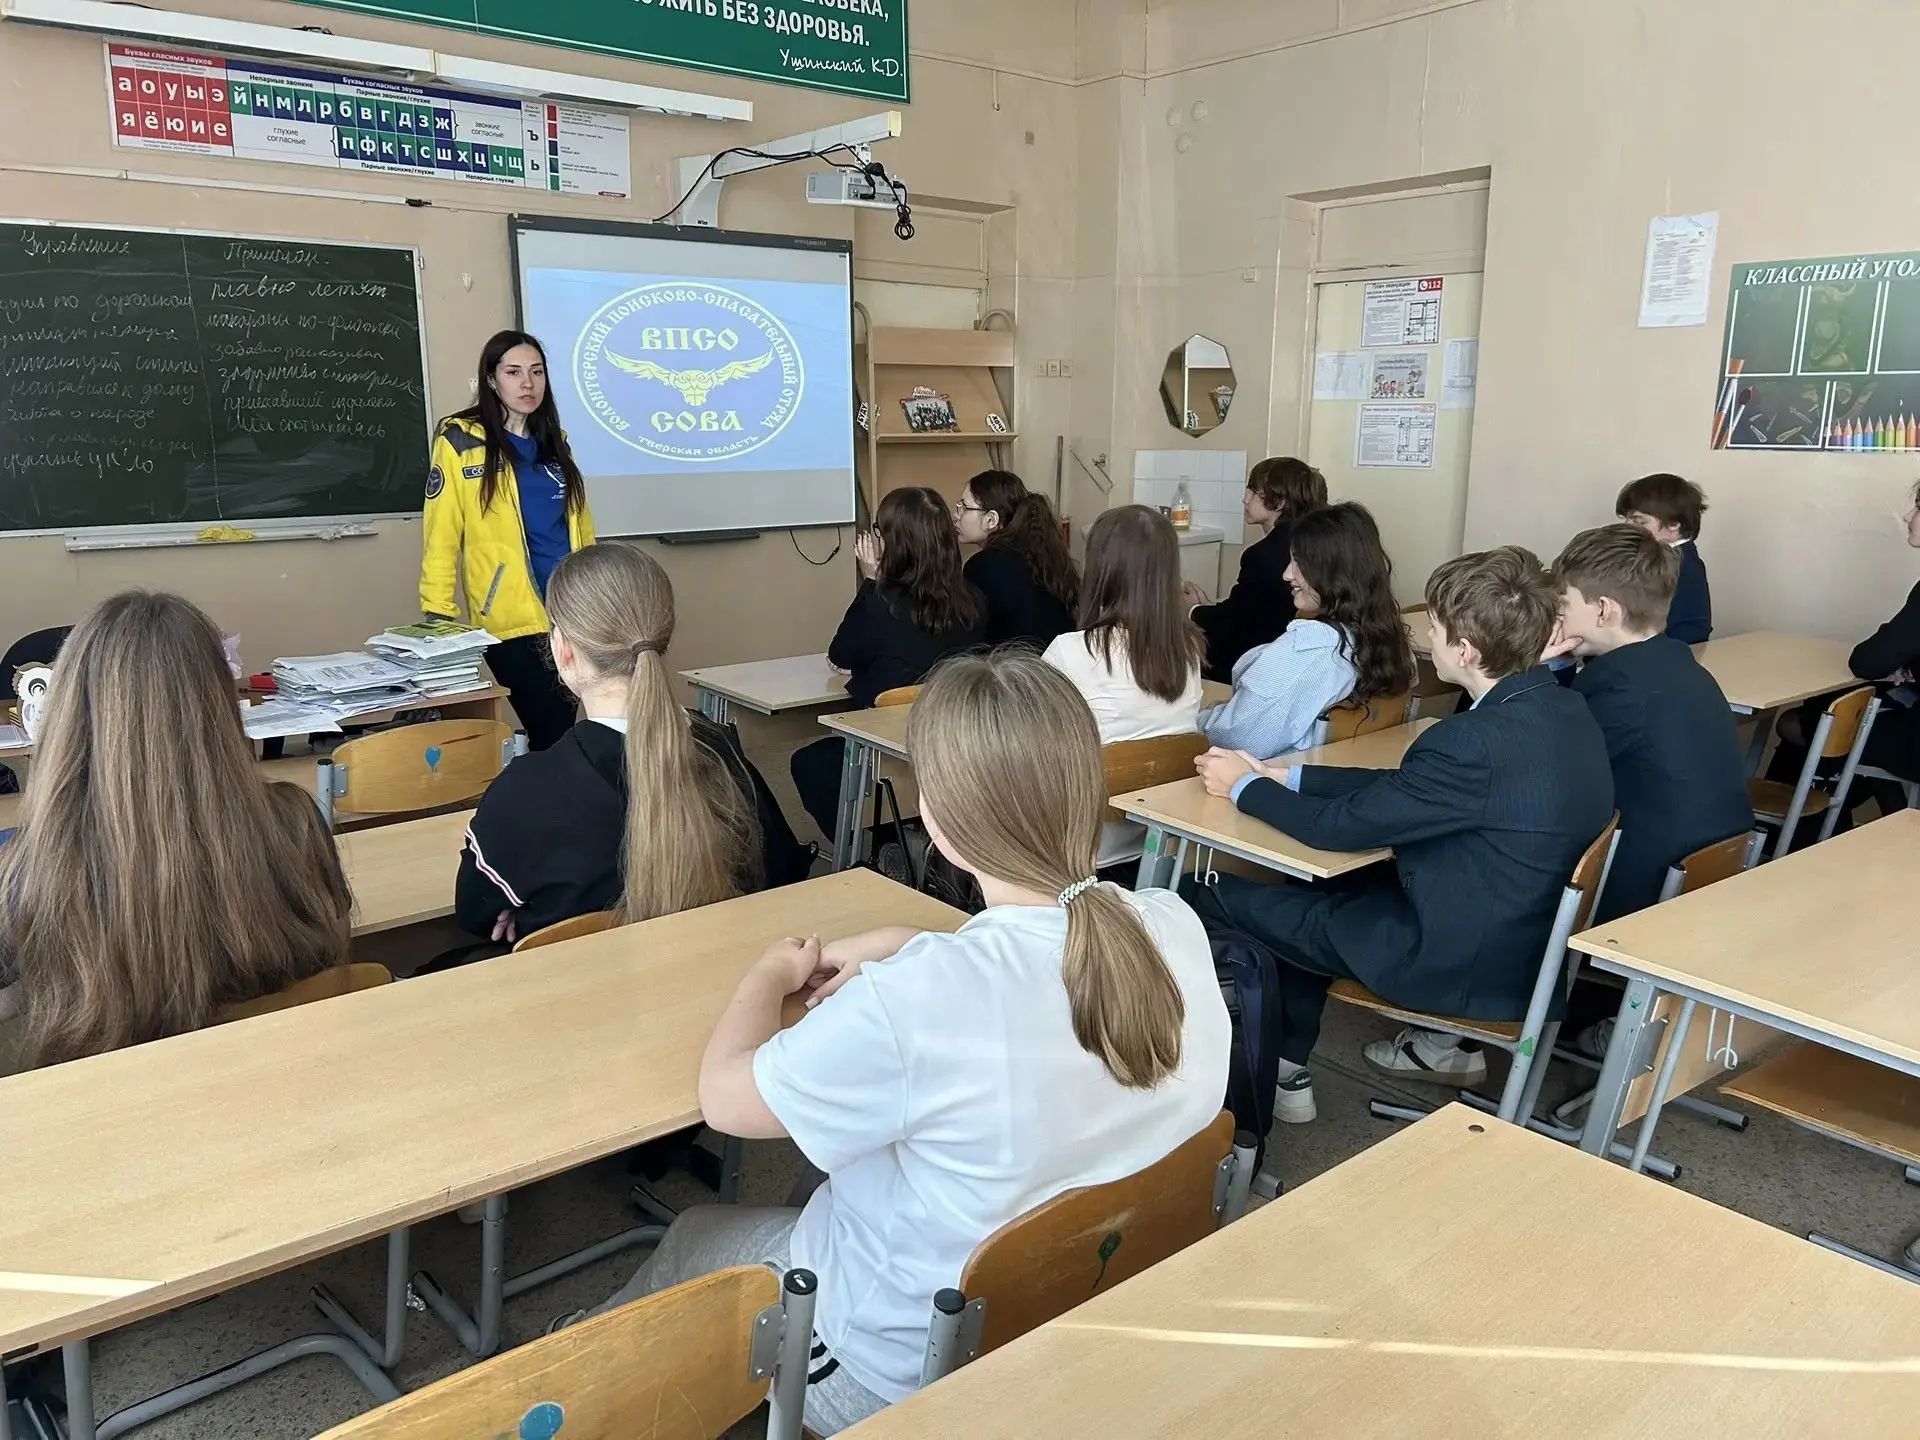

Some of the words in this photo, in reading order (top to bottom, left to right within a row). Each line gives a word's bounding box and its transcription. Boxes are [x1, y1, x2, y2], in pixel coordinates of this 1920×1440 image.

[722, 0, 760, 25] БЕЗ
[763, 6, 870, 46] ЗДОРОВЬЯ.
[124, 47, 151, 58] Буквы
[151, 51, 185, 62] гласных
[186, 55, 213, 66] звуков
[779, 48, 866, 73] Ушинский
[249, 74, 285, 85] Непарные
[286, 80, 314, 88] звонкие
[342, 76, 365, 87] Буквы
[365, 80, 401, 91] согласных
[401, 86, 424, 94] звуков
[118, 76, 132, 91] а
[141, 79, 156, 94] о
[165, 82, 178, 100] у
[185, 86, 205, 100] ы
[211, 88, 224, 102] э
[233, 86, 247, 105] й
[255, 93, 269, 108] н
[276, 96, 292, 111] м
[297, 99, 312, 113] л
[319, 101, 332, 119] р
[339, 100, 353, 118] б
[360, 107, 373, 120] в
[380, 109, 391, 122] г
[398, 112, 412, 128] д
[418, 115, 429, 128] з
[434, 116, 450, 131] ж
[356, 88, 381, 98] Парные
[382, 92, 431, 104] звонкие/глухие
[121, 112, 136, 127] я
[144, 111, 159, 130] ё
[166, 117, 185, 132] ю
[191, 119, 205, 134] и
[213, 122, 227, 137] е
[273, 126, 299, 136] глухие
[266, 134, 307, 145] согласные
[341, 136, 354, 150] п
[360, 135, 376, 155] ф
[382, 141, 394, 155] к
[401, 143, 413, 157] т
[419, 146, 431, 159] с
[436, 147, 452, 161] ш
[457, 150, 469, 163] х
[474, 153, 487, 168] ц
[492, 155, 504, 167] ч
[508, 157, 523, 172] щ
[360, 162, 386, 172] Парные
[387, 165, 435, 176] звонкие/глухие
[1744, 256, 1868, 286] КЛАССНЫЙ
[211, 274, 297, 301] плавно
[309, 281, 388, 298] летят
[1428, 281, 1442, 289] 112
[640, 326, 739, 351] ВПСО
[650, 410, 745, 433] СОВА
